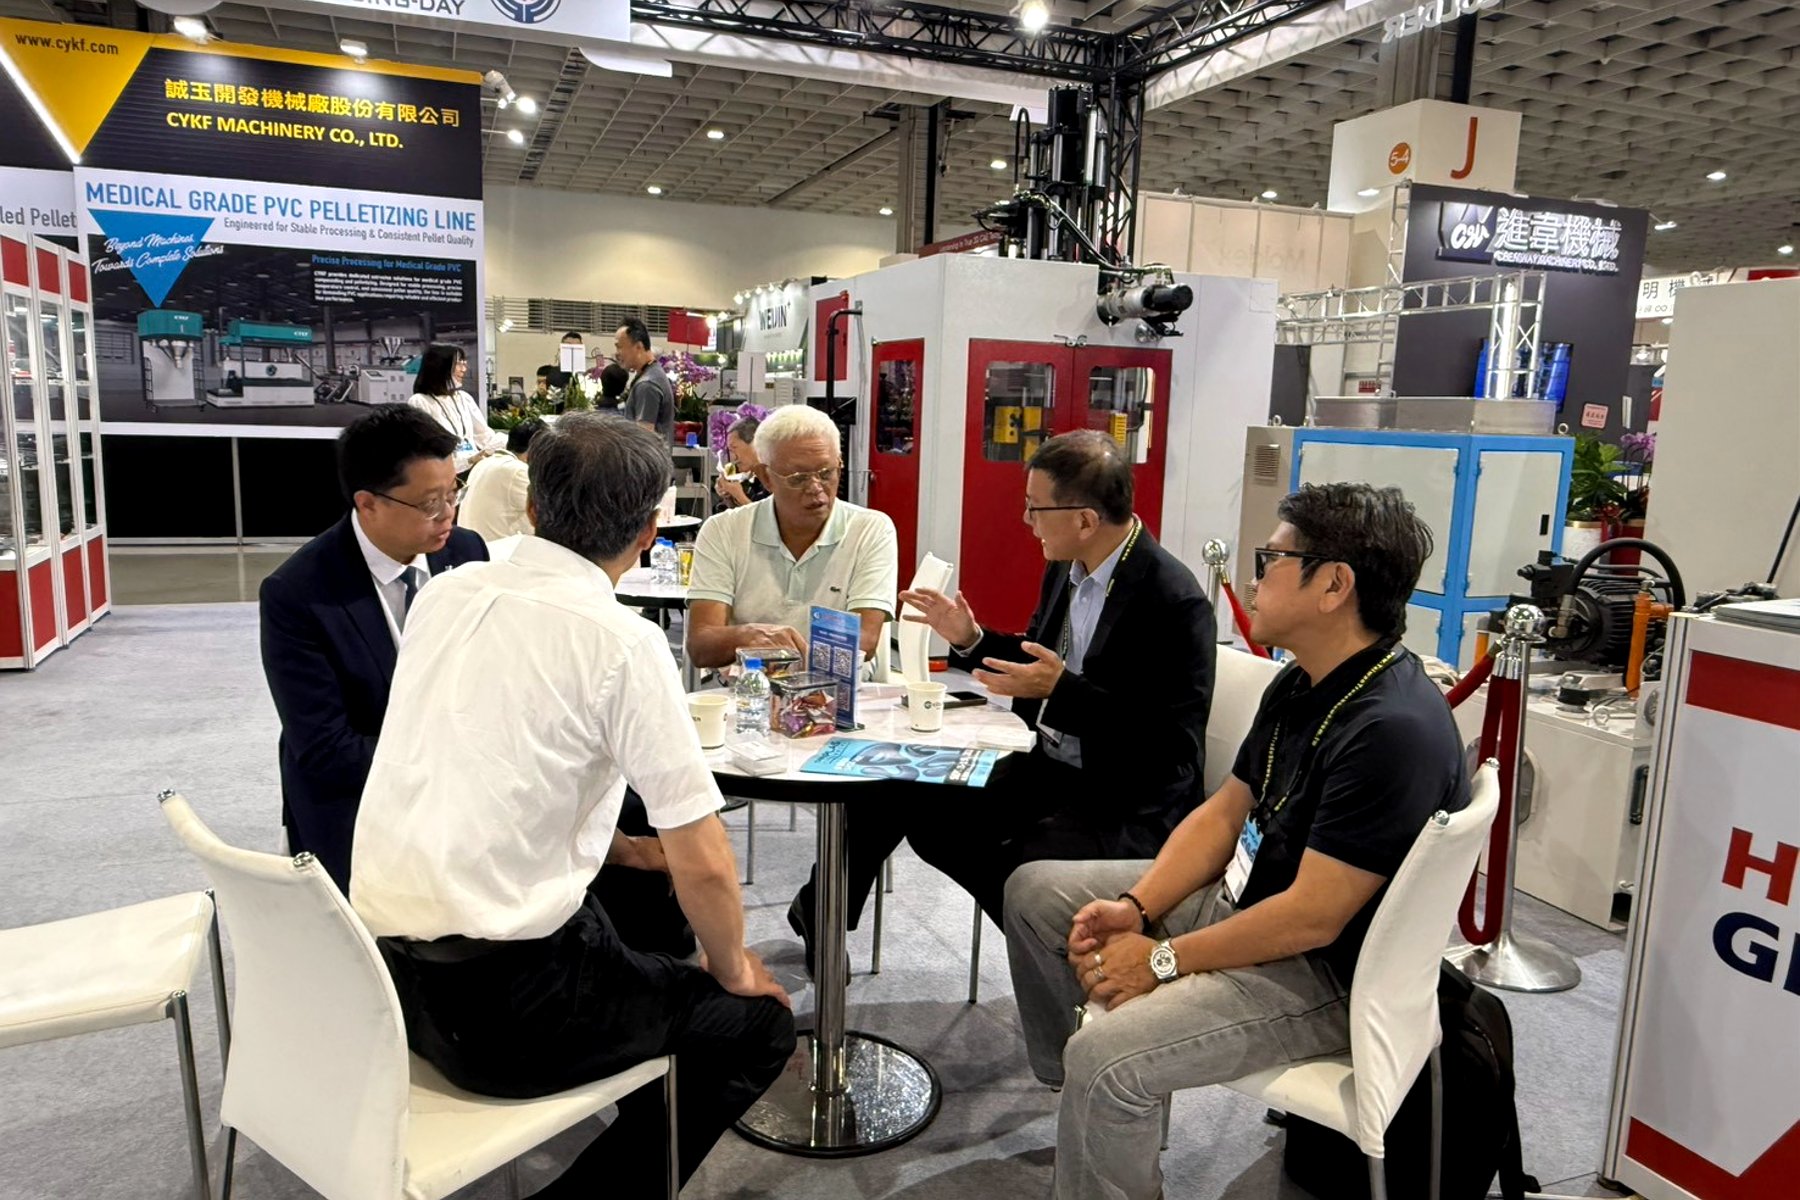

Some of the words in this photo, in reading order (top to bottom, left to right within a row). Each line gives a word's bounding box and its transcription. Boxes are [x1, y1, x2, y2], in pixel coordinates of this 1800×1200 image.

[15, 34, 119, 55] www.cykf.com
[165, 78, 460, 128] 誠玉開發機械廠股份有限公司
[166, 112, 213, 131] CYKF
[217, 117, 326, 142] MACHINERY
[329, 128, 365, 147] CO.,
[369, 132, 404, 149] LTD.
[1390, 149, 1410, 167] 5-4
[1451, 116, 1478, 180] J
[30, 207, 77, 228] Pellet
[86, 182, 182, 209] MEDICAL
[189, 190, 257, 215] GRADE
[264, 196, 303, 218] PVC
[310, 200, 428, 228] PELLETIZING
[435, 210, 477, 232] LINE
[104, 236, 145, 254] Beyond
[223, 217, 274, 233] Engineered
[276, 221, 289, 232] for
[290, 222, 318, 235] Stable
[320, 224, 367, 240] Processing
[369, 229, 376, 239] &
[378, 229, 421, 242] Consistent
[423, 232, 446, 244] Pellet
[447, 234, 475, 248] Quality
[1494, 207, 1623, 260] 進韋機械
[91, 257, 134, 275] Towards
[136, 251, 181, 270] Complete
[182, 244, 224, 263] Solutions
[312, 254, 340, 265] Precise
[341, 257, 382, 269] Processing
[383, 259, 394, 268] for
[395, 260, 424, 270] Medical
[425, 261, 446, 271] Grade
[447, 263, 462, 273] PVC
